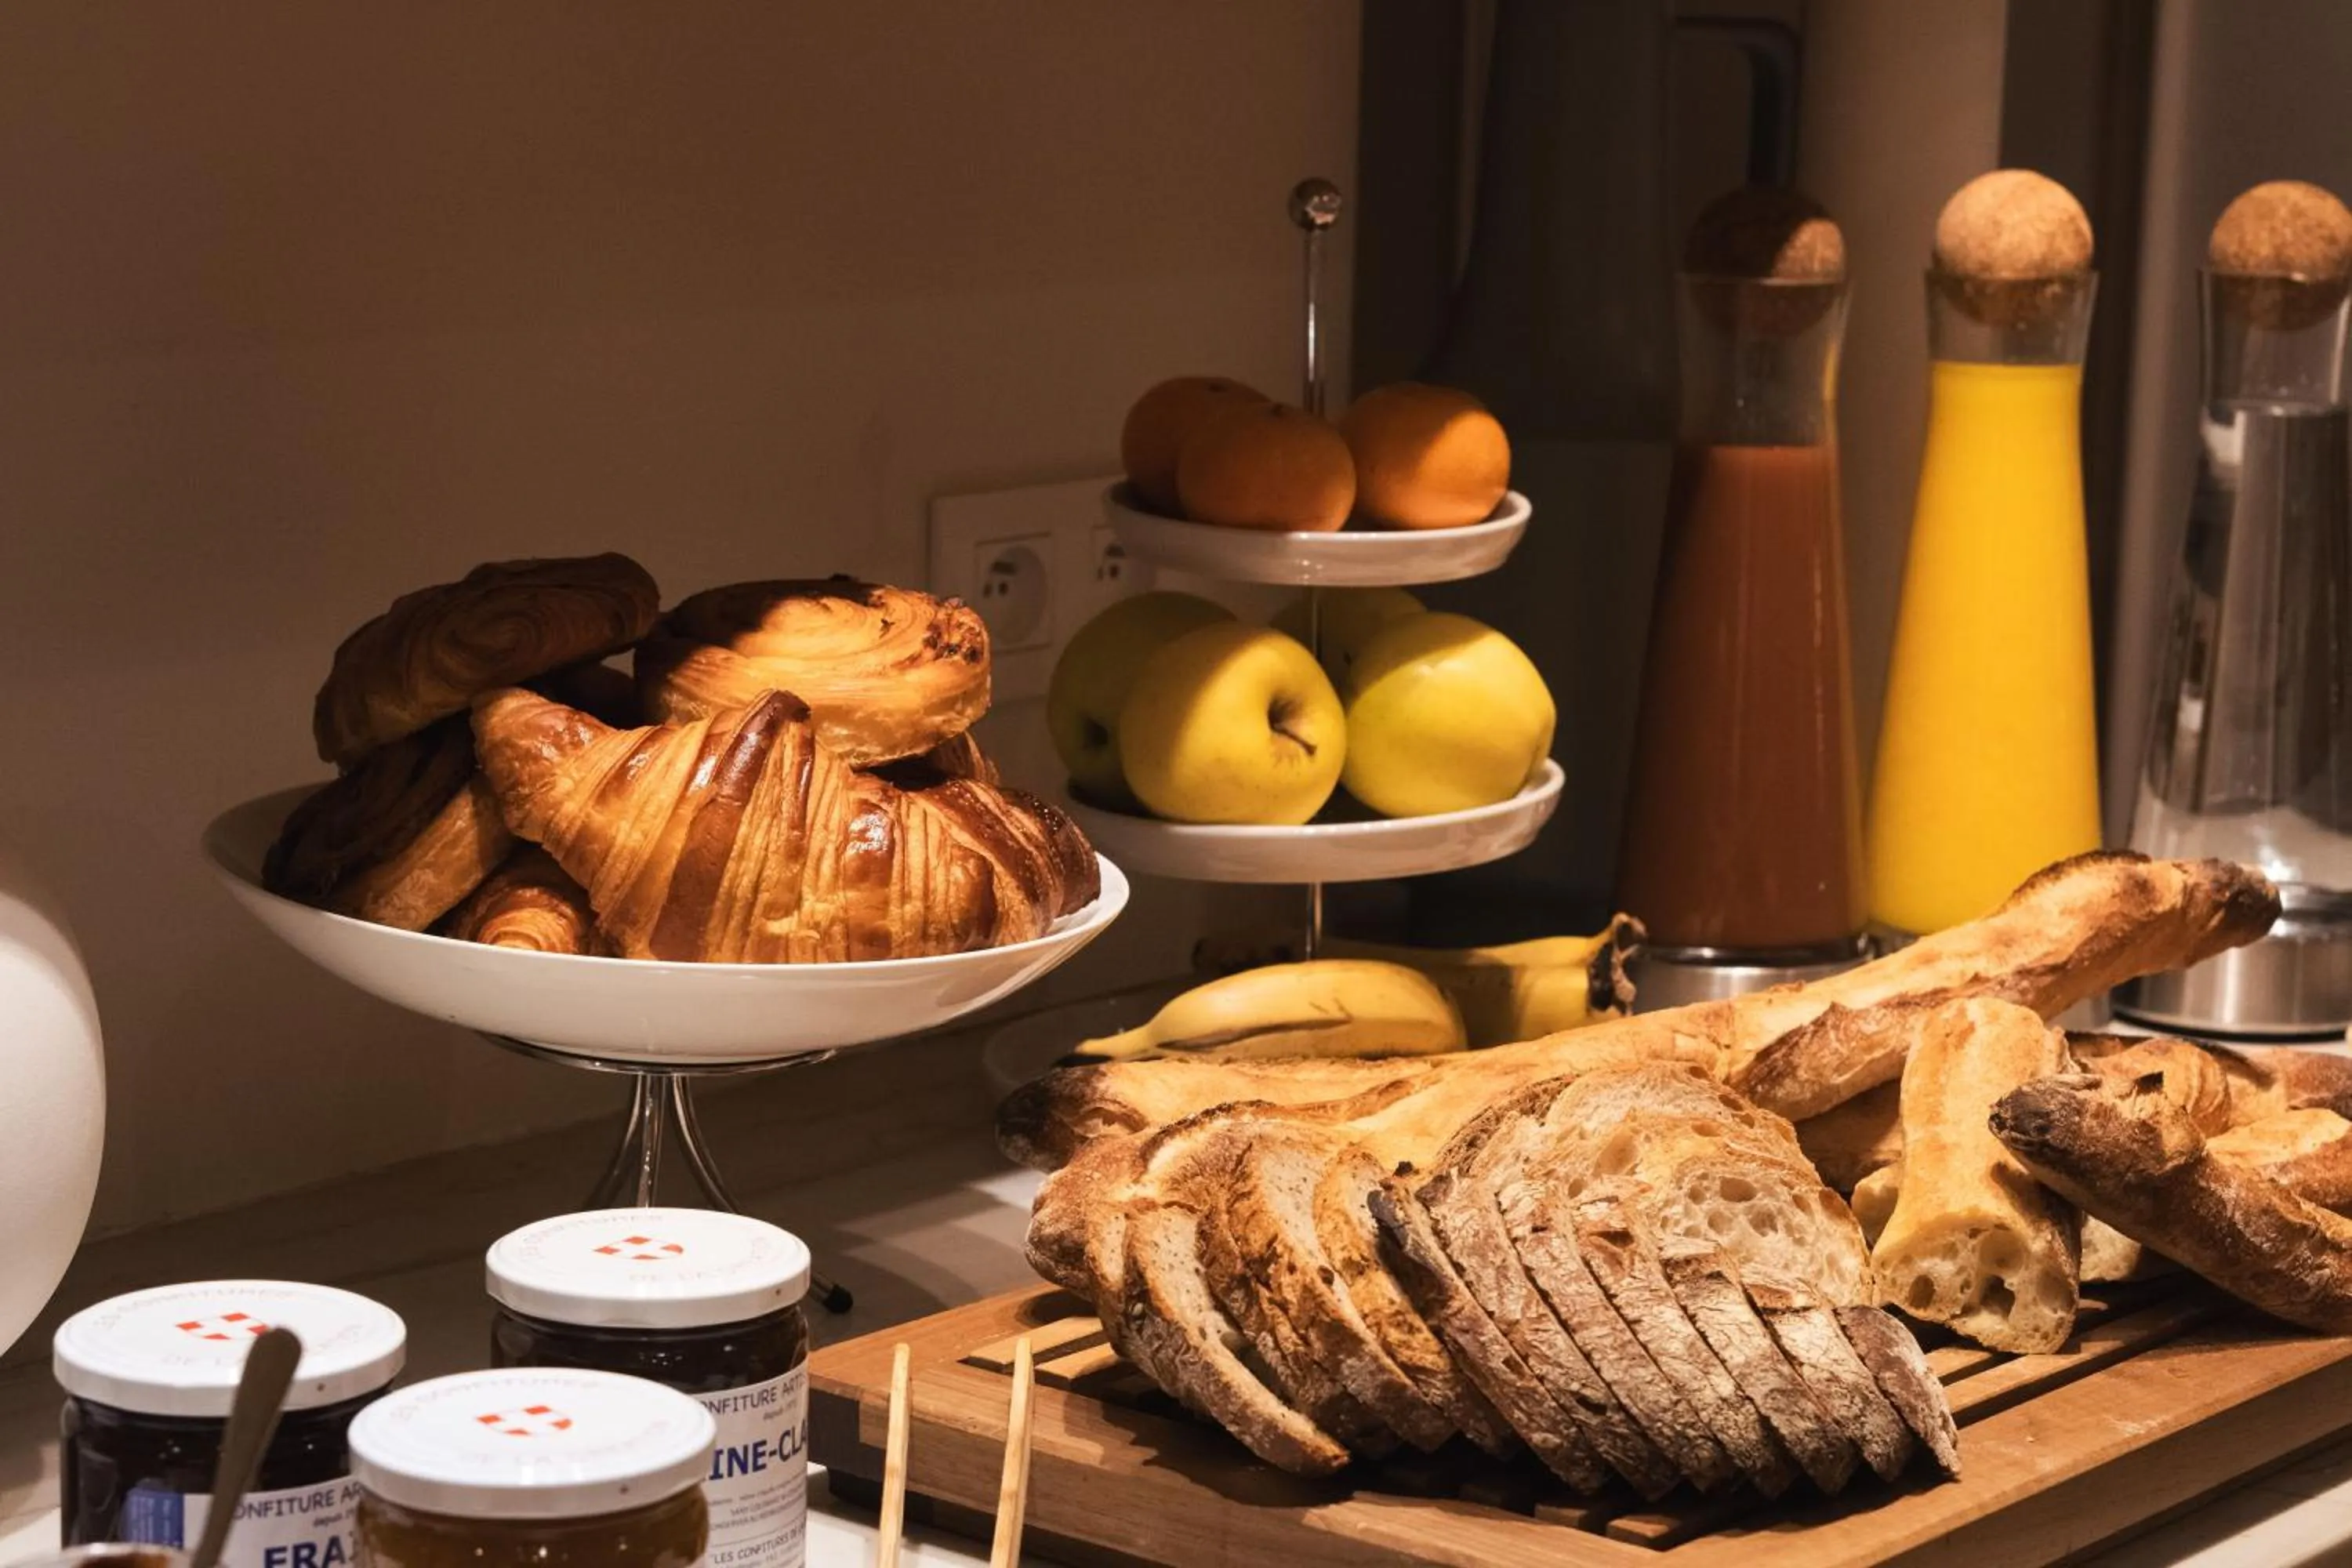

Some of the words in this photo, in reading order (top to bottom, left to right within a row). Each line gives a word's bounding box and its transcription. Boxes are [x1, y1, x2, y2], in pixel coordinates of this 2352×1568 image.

[700, 1387, 777, 1416] NFITURE
[709, 1418, 807, 1481] INE-CLA
[235, 1489, 336, 1520] ONFITURE
[340, 1481, 364, 1504] AR
